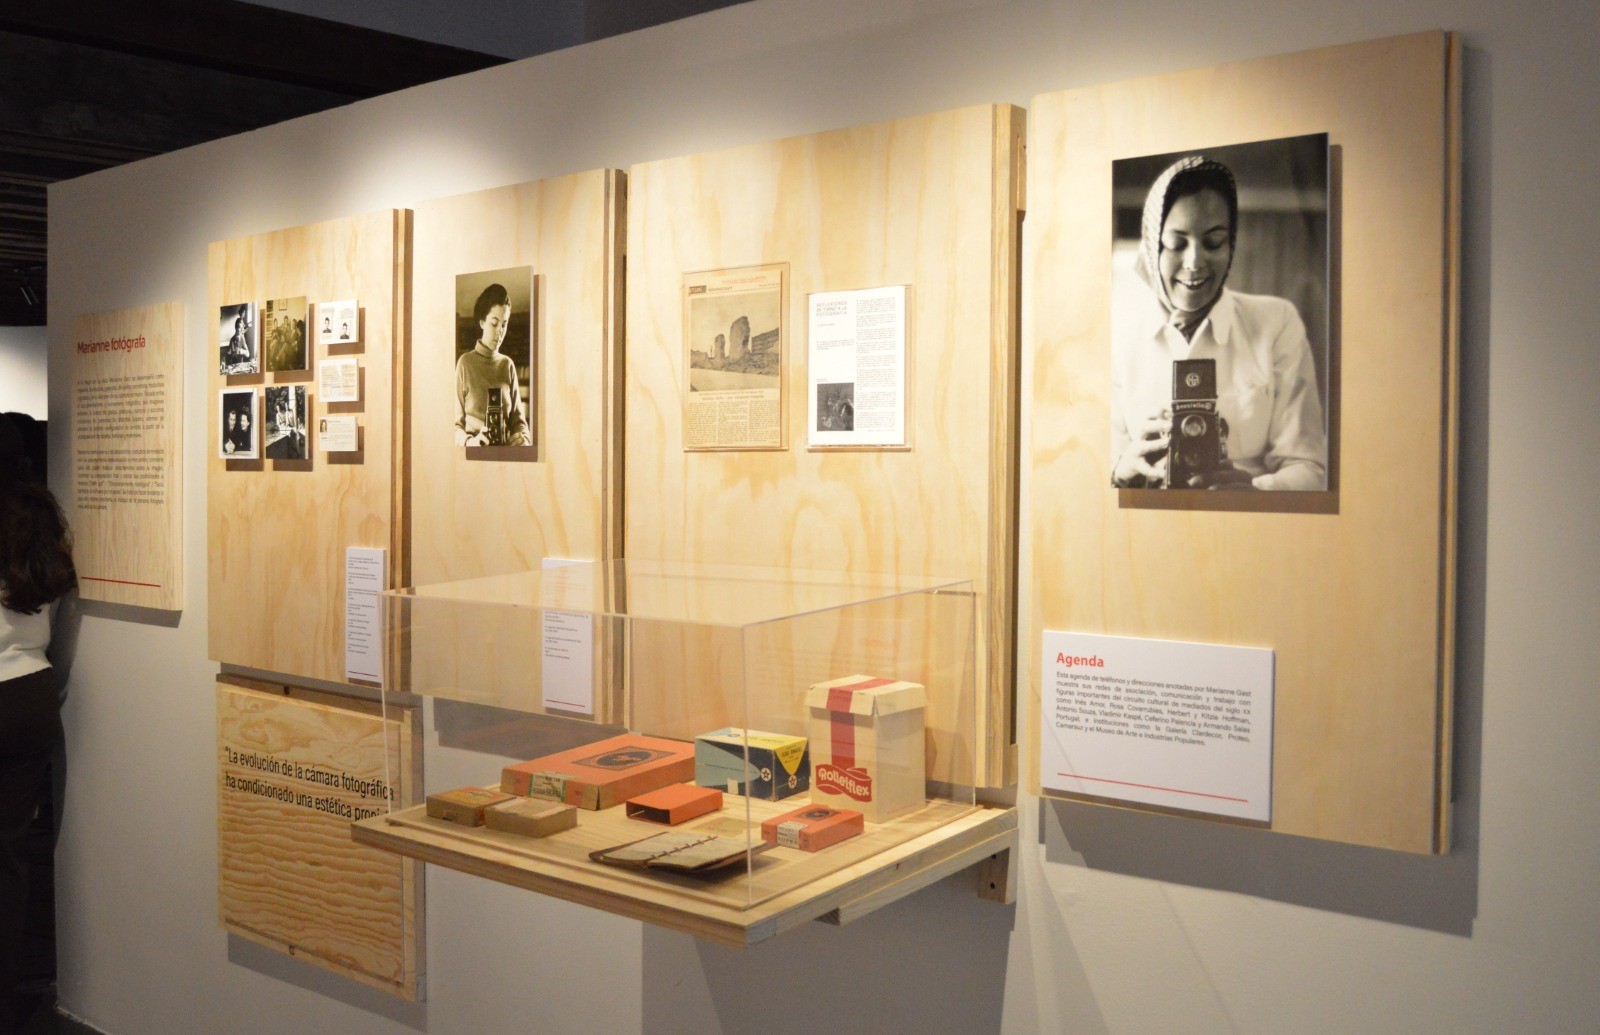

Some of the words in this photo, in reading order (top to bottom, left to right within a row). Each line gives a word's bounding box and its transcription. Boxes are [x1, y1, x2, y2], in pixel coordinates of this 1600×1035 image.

[77, 340, 110, 354] Marianne
[111, 335, 146, 352] fotógrafa
[1057, 652, 1104, 667] Agenda
[239, 753, 280, 774] evolución
[282, 760, 293, 777] de
[295, 761, 303, 780] la
[305, 765, 340, 788] cámara
[342, 772, 394, 801] fotográfica
[818, 768, 870, 796] Rolleiflex
[225, 771, 236, 789] ha
[237, 775, 294, 803] condicionado
[296, 791, 313, 808] una
[315, 795, 352, 818] estética
